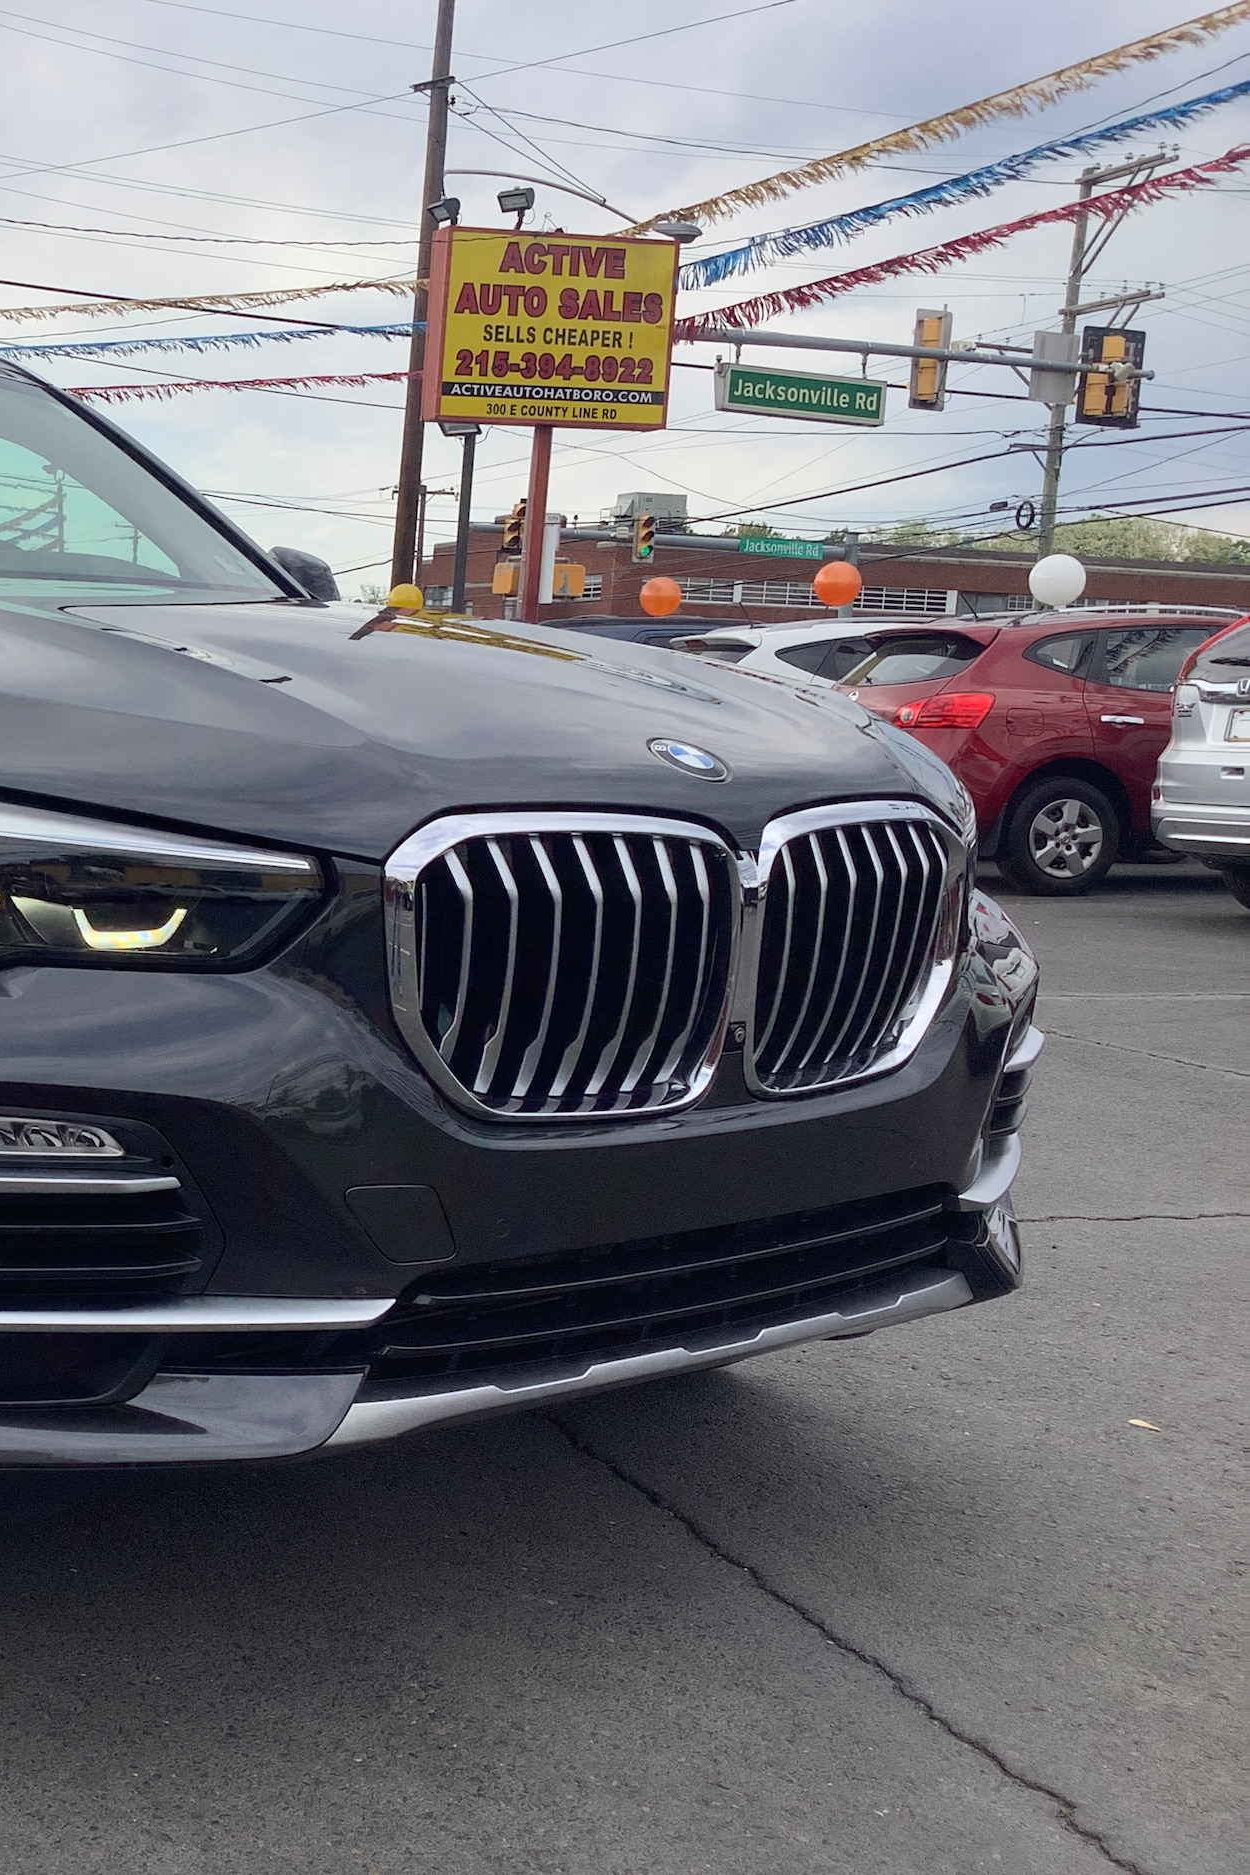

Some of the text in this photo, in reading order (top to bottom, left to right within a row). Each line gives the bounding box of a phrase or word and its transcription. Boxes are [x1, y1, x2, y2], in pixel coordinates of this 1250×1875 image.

[499, 242, 626, 279] ACTIVE
[454, 283, 663, 324] AUTO SALES
[483, 324, 536, 345] SELLS
[543, 327, 622, 348] CHEAPER
[455, 349, 653, 384] 215-394-8922
[451, 383, 652, 403] ACTIVEAUTOHATBORO.COM
[733, 378, 878, 411] Jacksonville Rd
[486, 403, 617, 420] 300 E COUNTY LINE RD
[743, 539, 819, 557] Jacksonville Rd
